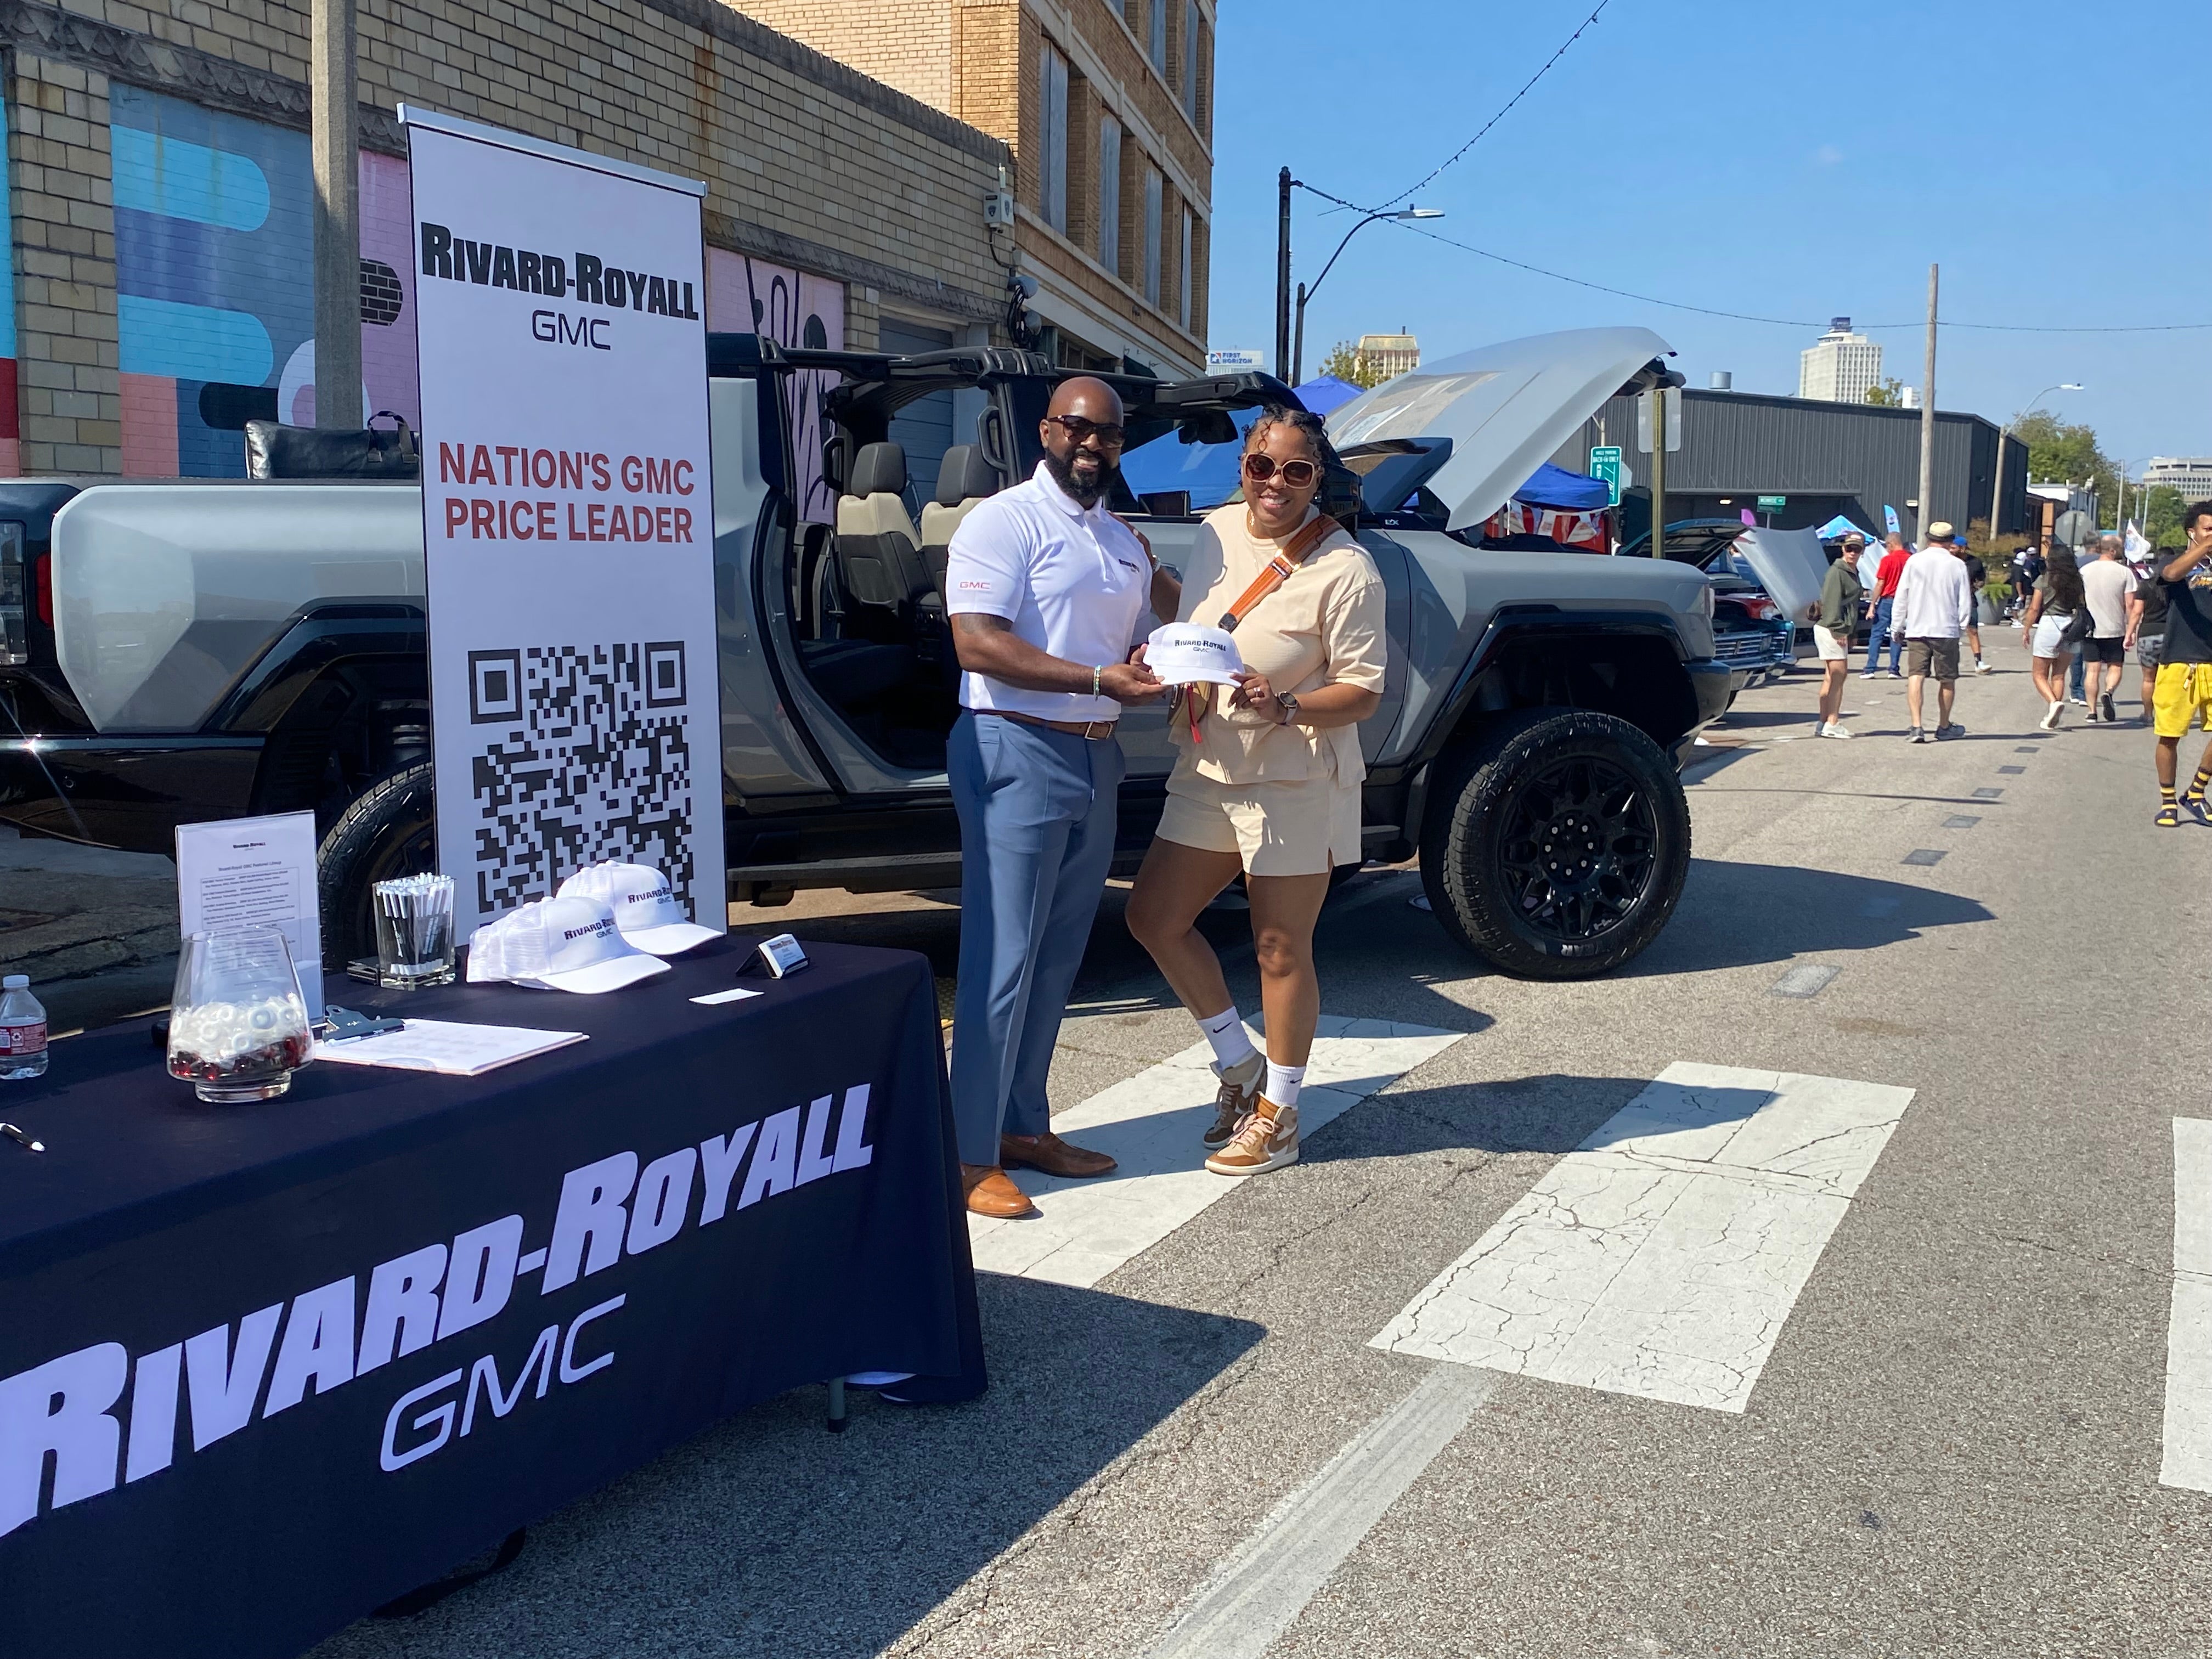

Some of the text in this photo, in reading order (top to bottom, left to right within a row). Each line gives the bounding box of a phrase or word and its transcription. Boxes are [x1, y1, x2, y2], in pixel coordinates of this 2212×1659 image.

[421, 222, 699, 321] RIVARD-ROYALL
[532, 309, 611, 350] GMC
[440, 442, 694, 495] NATION'S GMC
[445, 498, 692, 543] PRICE LEADER
[1175, 640, 1226, 651] RIVARD-ROYALL
[0, 1083, 873, 1537] RIVARD-ROYALL
[380, 1293, 627, 1472] GMC
